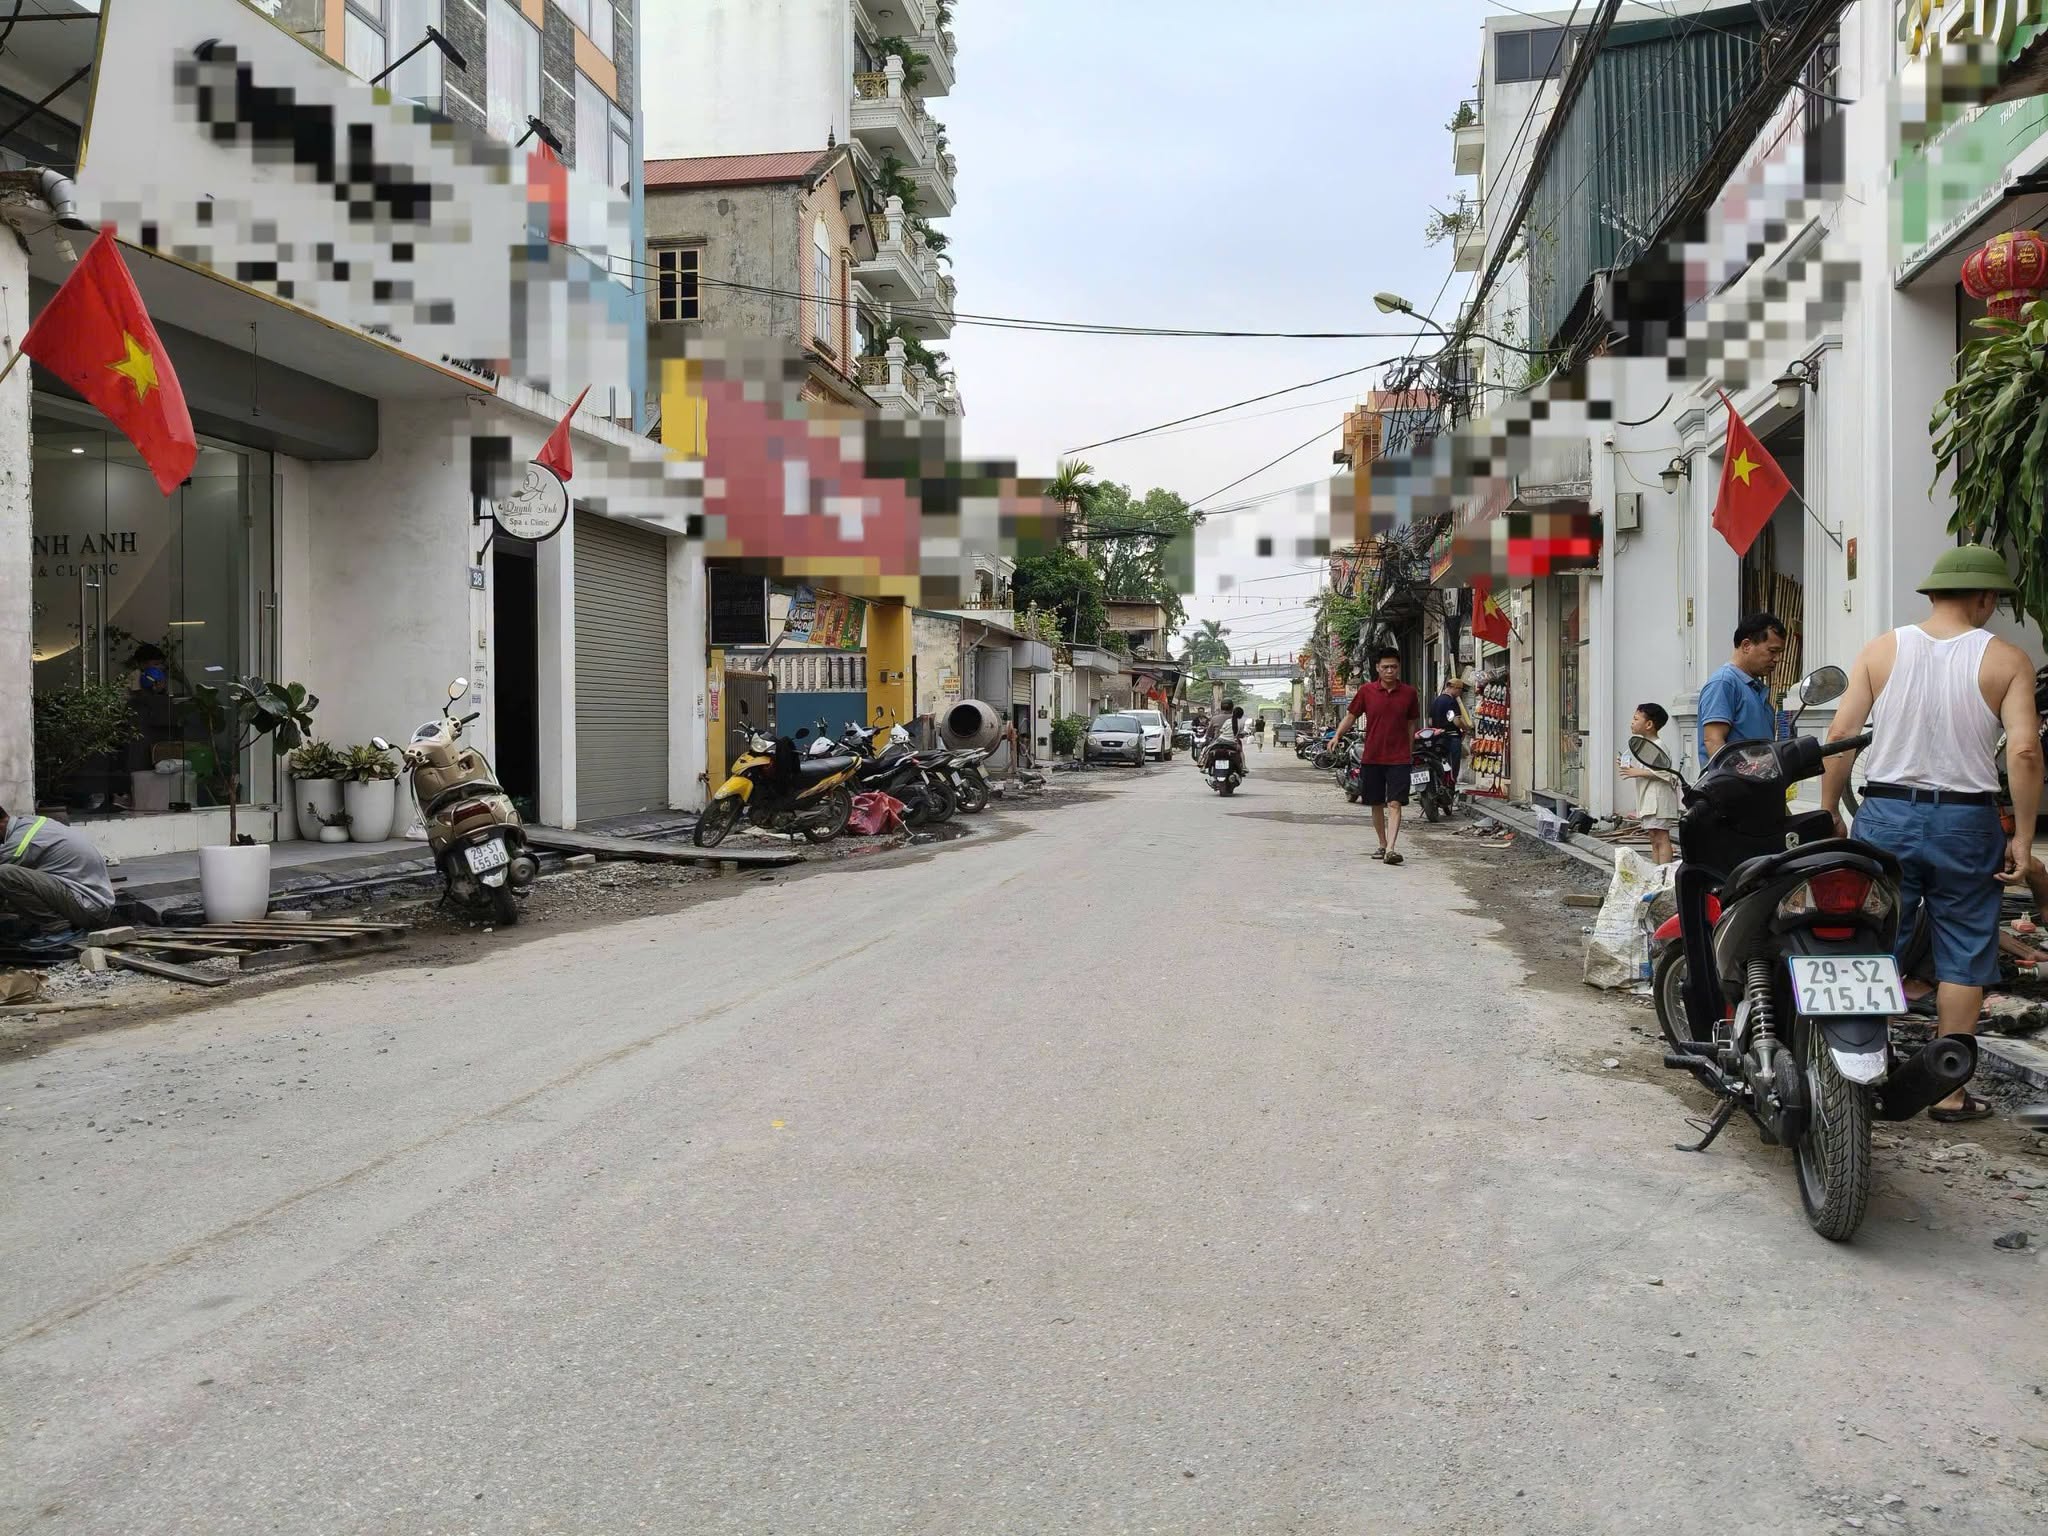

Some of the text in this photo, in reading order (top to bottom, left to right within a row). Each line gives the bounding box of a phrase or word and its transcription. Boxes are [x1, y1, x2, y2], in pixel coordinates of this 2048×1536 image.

[80, 531, 138, 554] ANH
[473, 572, 483, 586] 28
[470, 841, 499, 860] 29-S1
[473, 851, 506, 872] 455.90
[1807, 960, 1884, 984] 29-S2
[1803, 986, 1897, 1011] 215.41
